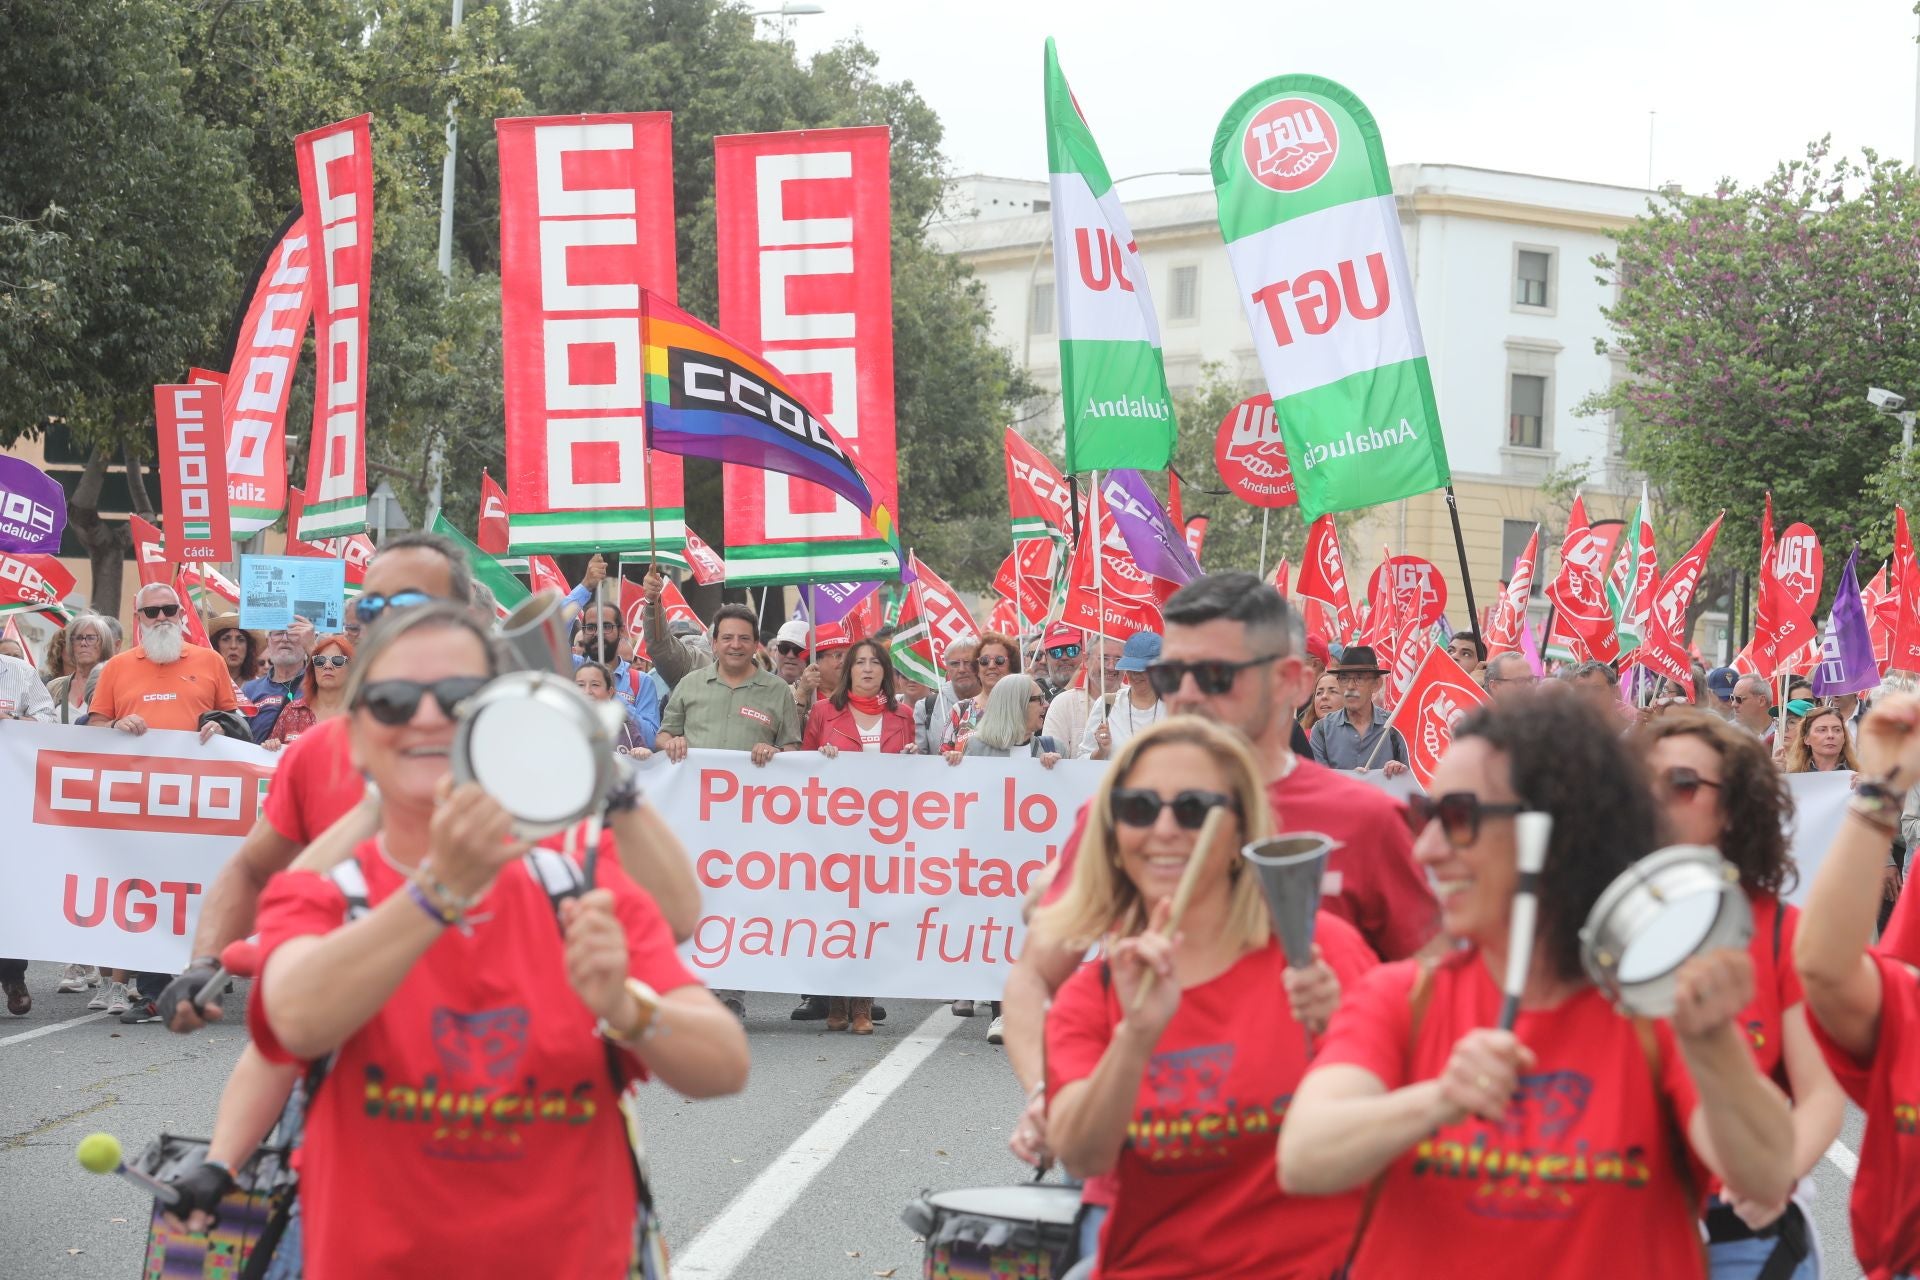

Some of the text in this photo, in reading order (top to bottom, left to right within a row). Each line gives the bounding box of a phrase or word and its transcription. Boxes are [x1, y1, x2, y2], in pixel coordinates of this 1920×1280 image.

[312, 130, 358, 502] CCOO
[535, 123, 646, 508] CCOO
[174, 390, 209, 516] CCOO
[227, 482, 266, 503] ádiz
[184, 547, 215, 558] Cádiz
[1775, 535, 1815, 580] UGT
[50, 766, 242, 820] CCOO
[699, 769, 1058, 845] Proteger lo
[63, 873, 202, 936] UGT
[692, 907, 889, 968] ganar
